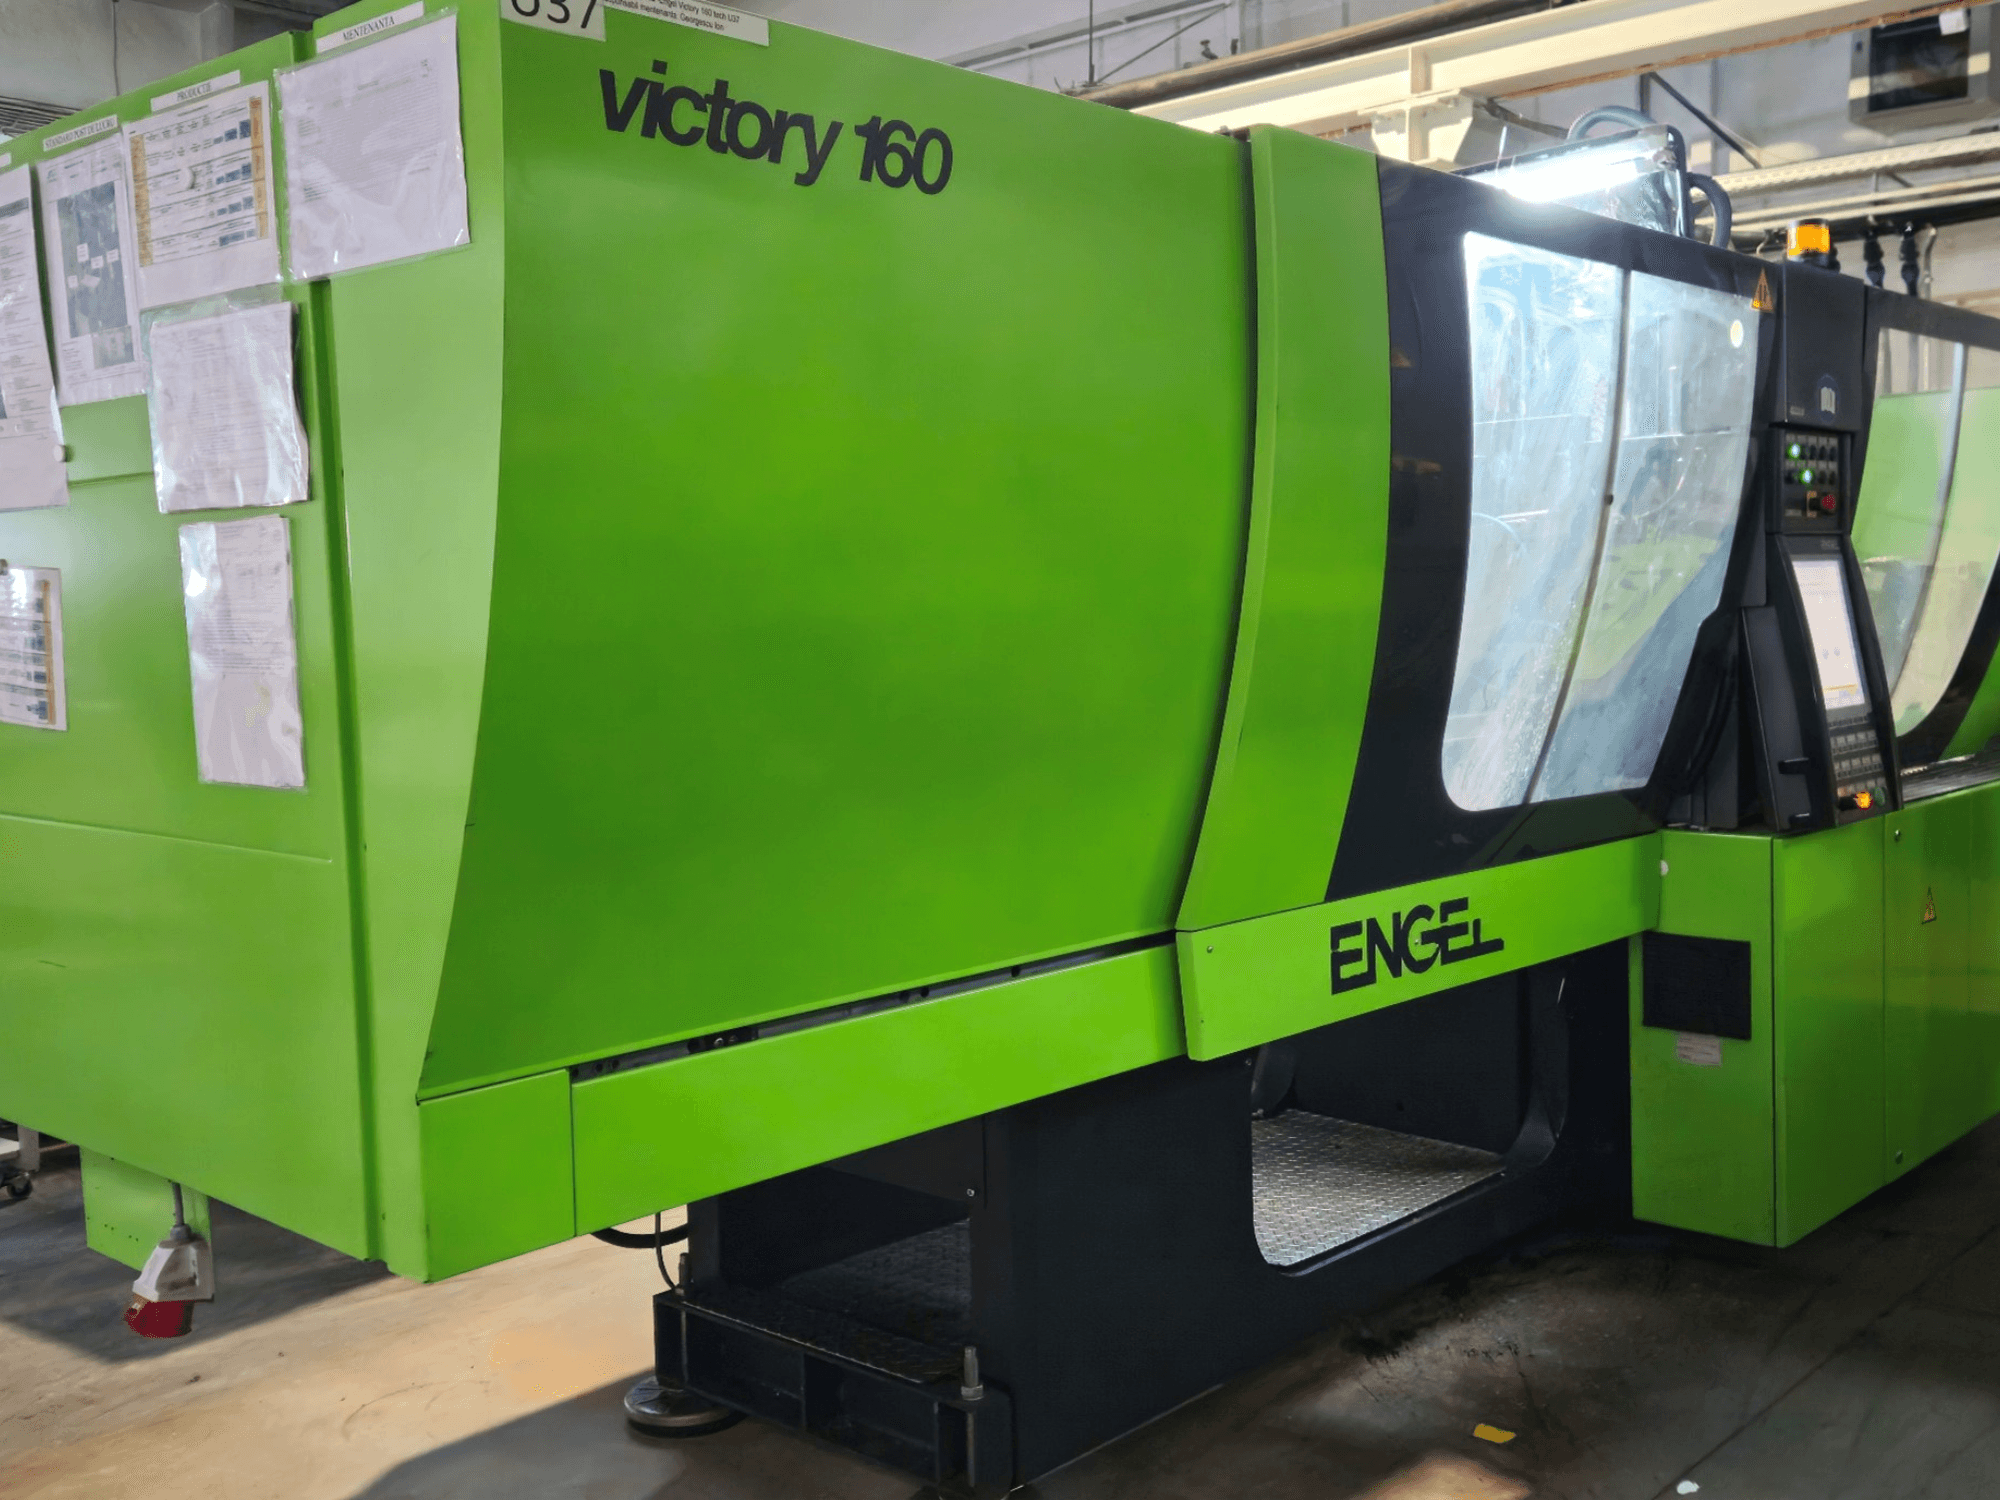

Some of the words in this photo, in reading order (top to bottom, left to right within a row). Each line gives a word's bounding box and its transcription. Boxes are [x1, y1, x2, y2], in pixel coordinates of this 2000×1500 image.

[678, 1, 699, 15] Victory
[700, 7, 713, 17] 160
[727, 13, 741, 23] U37
[679, 12, 714, 28] Georgescu
[713, 21, 725, 31] Ion
[343, 16, 395, 40] MENTENANTA
[600, 59, 844, 187] victory
[854, 115, 954, 195] 160
[1330, 897, 1504, 995] ENGEL
